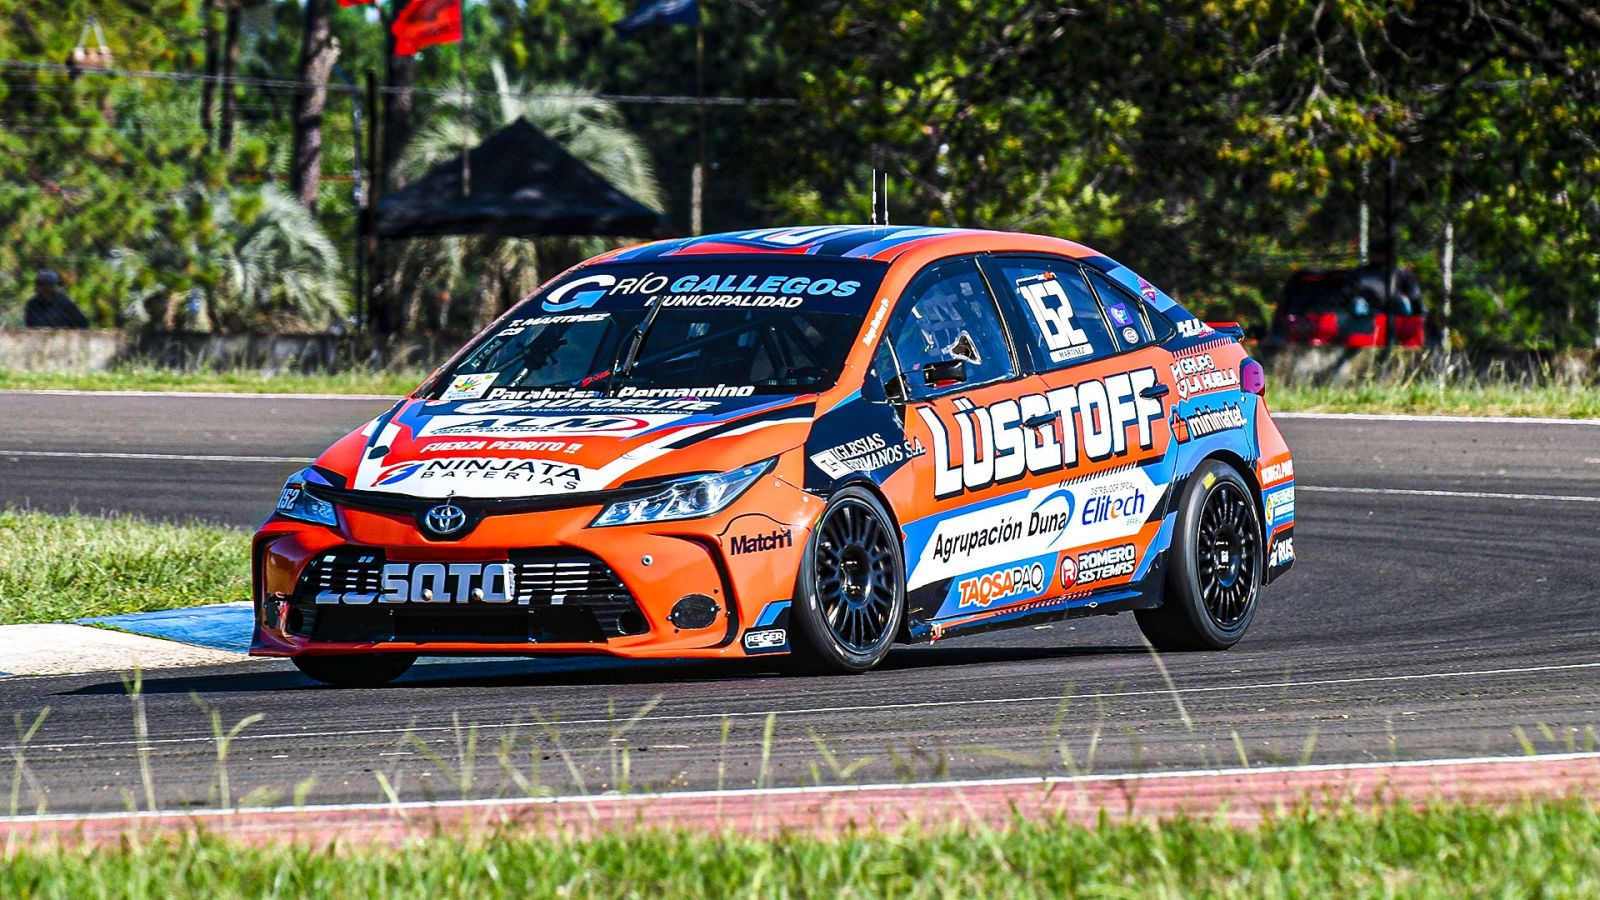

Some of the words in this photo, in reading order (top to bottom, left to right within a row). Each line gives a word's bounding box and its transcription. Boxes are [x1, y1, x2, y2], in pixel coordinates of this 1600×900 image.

[609, 272, 669, 296] RÍO
[670, 275, 861, 297] GALLEGOS
[521, 312, 611, 326] MARTINEZ
[1019, 279, 1088, 350] 152
[1180, 353, 1215, 375] GRUPO
[1200, 368, 1240, 391] HUELLA
[519, 397, 722, 411] AUTOELITE
[430, 418, 626, 433] ALM
[420, 441, 486, 453] FUERZA
[486, 441, 565, 452] PEDRITO
[830, 433, 886, 460] IGLESIAS
[841, 444, 903, 471] HERMANOS
[420, 470, 578, 490] BATERIAS
[427, 460, 581, 481] NINJATA
[1082, 488, 1145, 525] Elitech
[933, 516, 1022, 563] Agrupación
[1027, 511, 1067, 536] Duna
[1078, 545, 1135, 570] ROMERO
[1077, 560, 1135, 584] SISTEMAS
